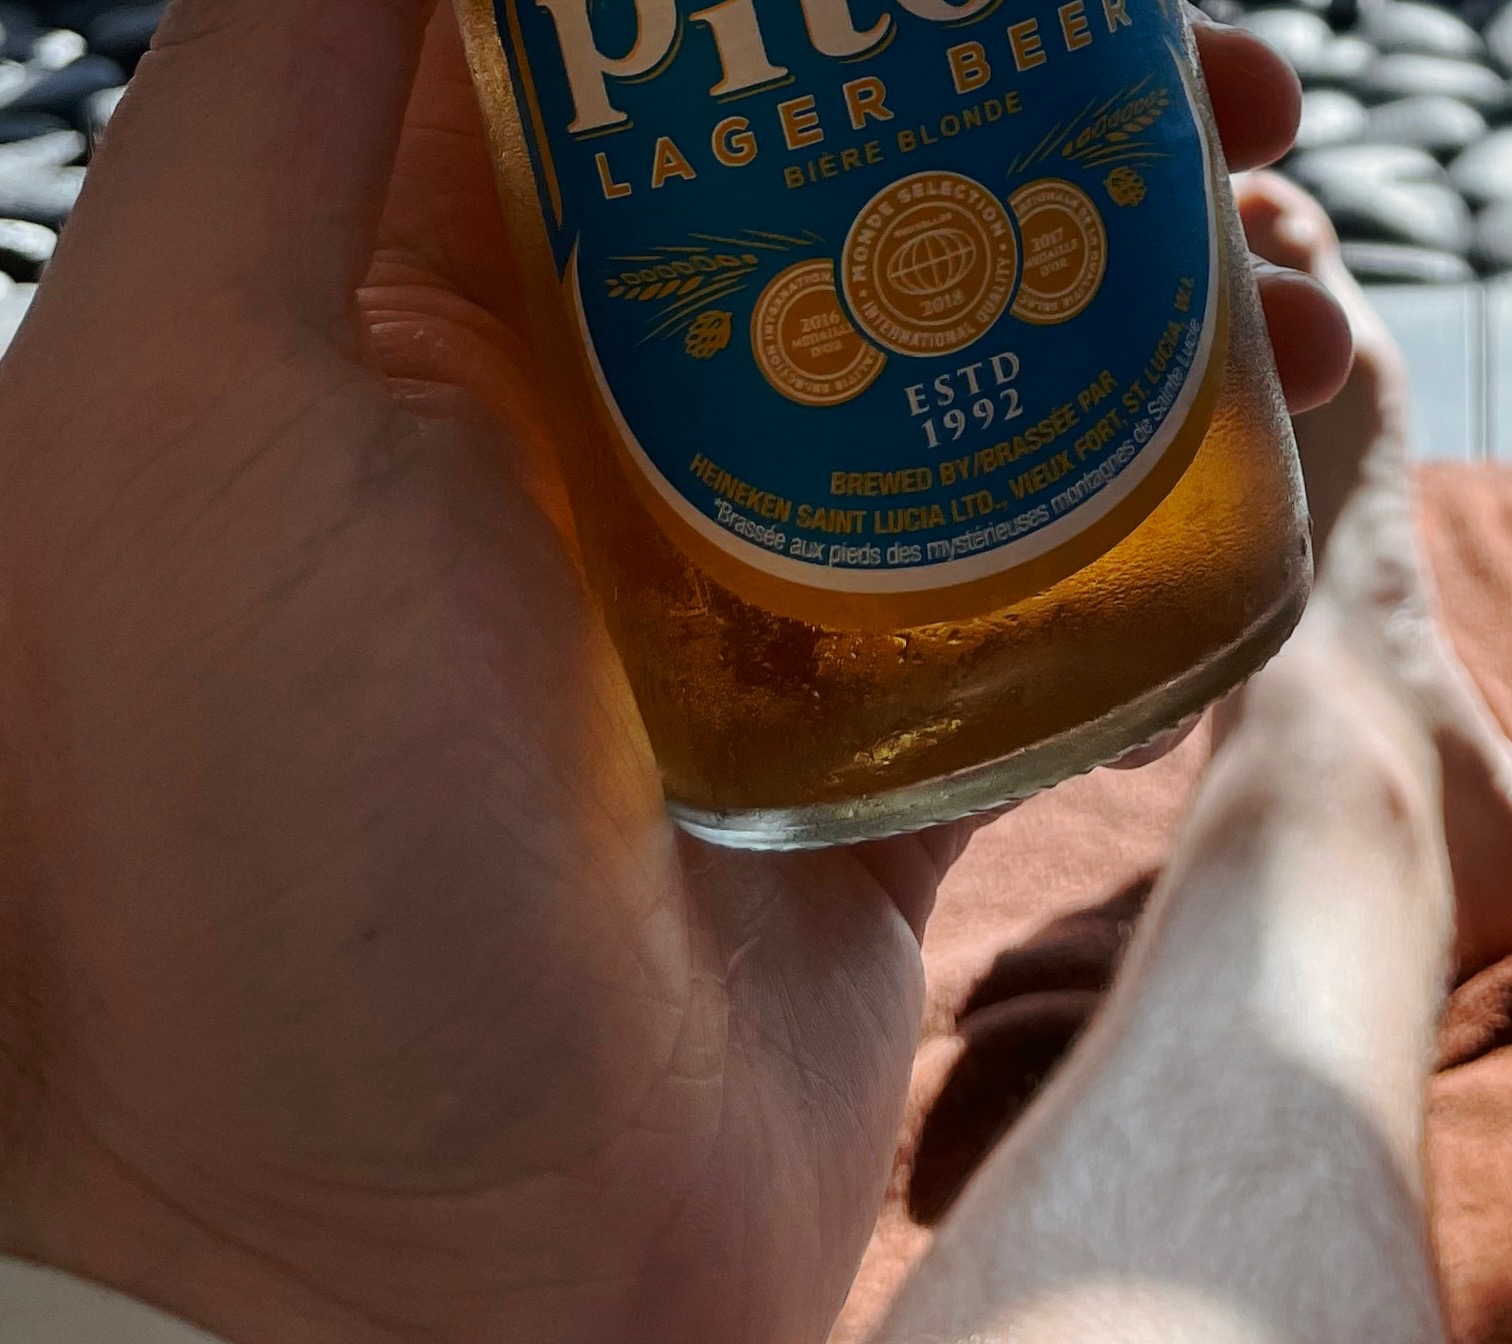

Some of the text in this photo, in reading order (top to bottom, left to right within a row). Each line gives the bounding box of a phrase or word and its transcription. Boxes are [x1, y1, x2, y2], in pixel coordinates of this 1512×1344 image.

[595, 77, 894, 200] LAGER
[784, 90, 1022, 189] BIÈRE BLONDE
[851, 180, 1006, 283] MONDE SELECTION
[800, 310, 840, 333] 2016
[860, 256, 1011, 349] INTERNATIONAL QUALITY
[904, 351, 1021, 417] ESTD
[921, 388, 1024, 449] 1992
[789, 537, 826, 562] aux
[828, 542, 881, 568] pieds
[886, 541, 922, 565] des
[927, 504, 1050, 562] mystérieuses
[1051, 439, 1136, 514] montagnes
[1133, 418, 1153, 443] de
[1147, 366, 1183, 421] Sainte
[1175, 317, 1200, 369] Lucie
[830, 466, 933, 497] BREWED
[1077, 369, 1118, 412] PAR
[688, 451, 793, 523] HEINEKEN
[796, 503, 868, 534] SAINT
[874, 504, 946, 535] LUCIA
[1008, 450, 1076, 500] VIEUX
